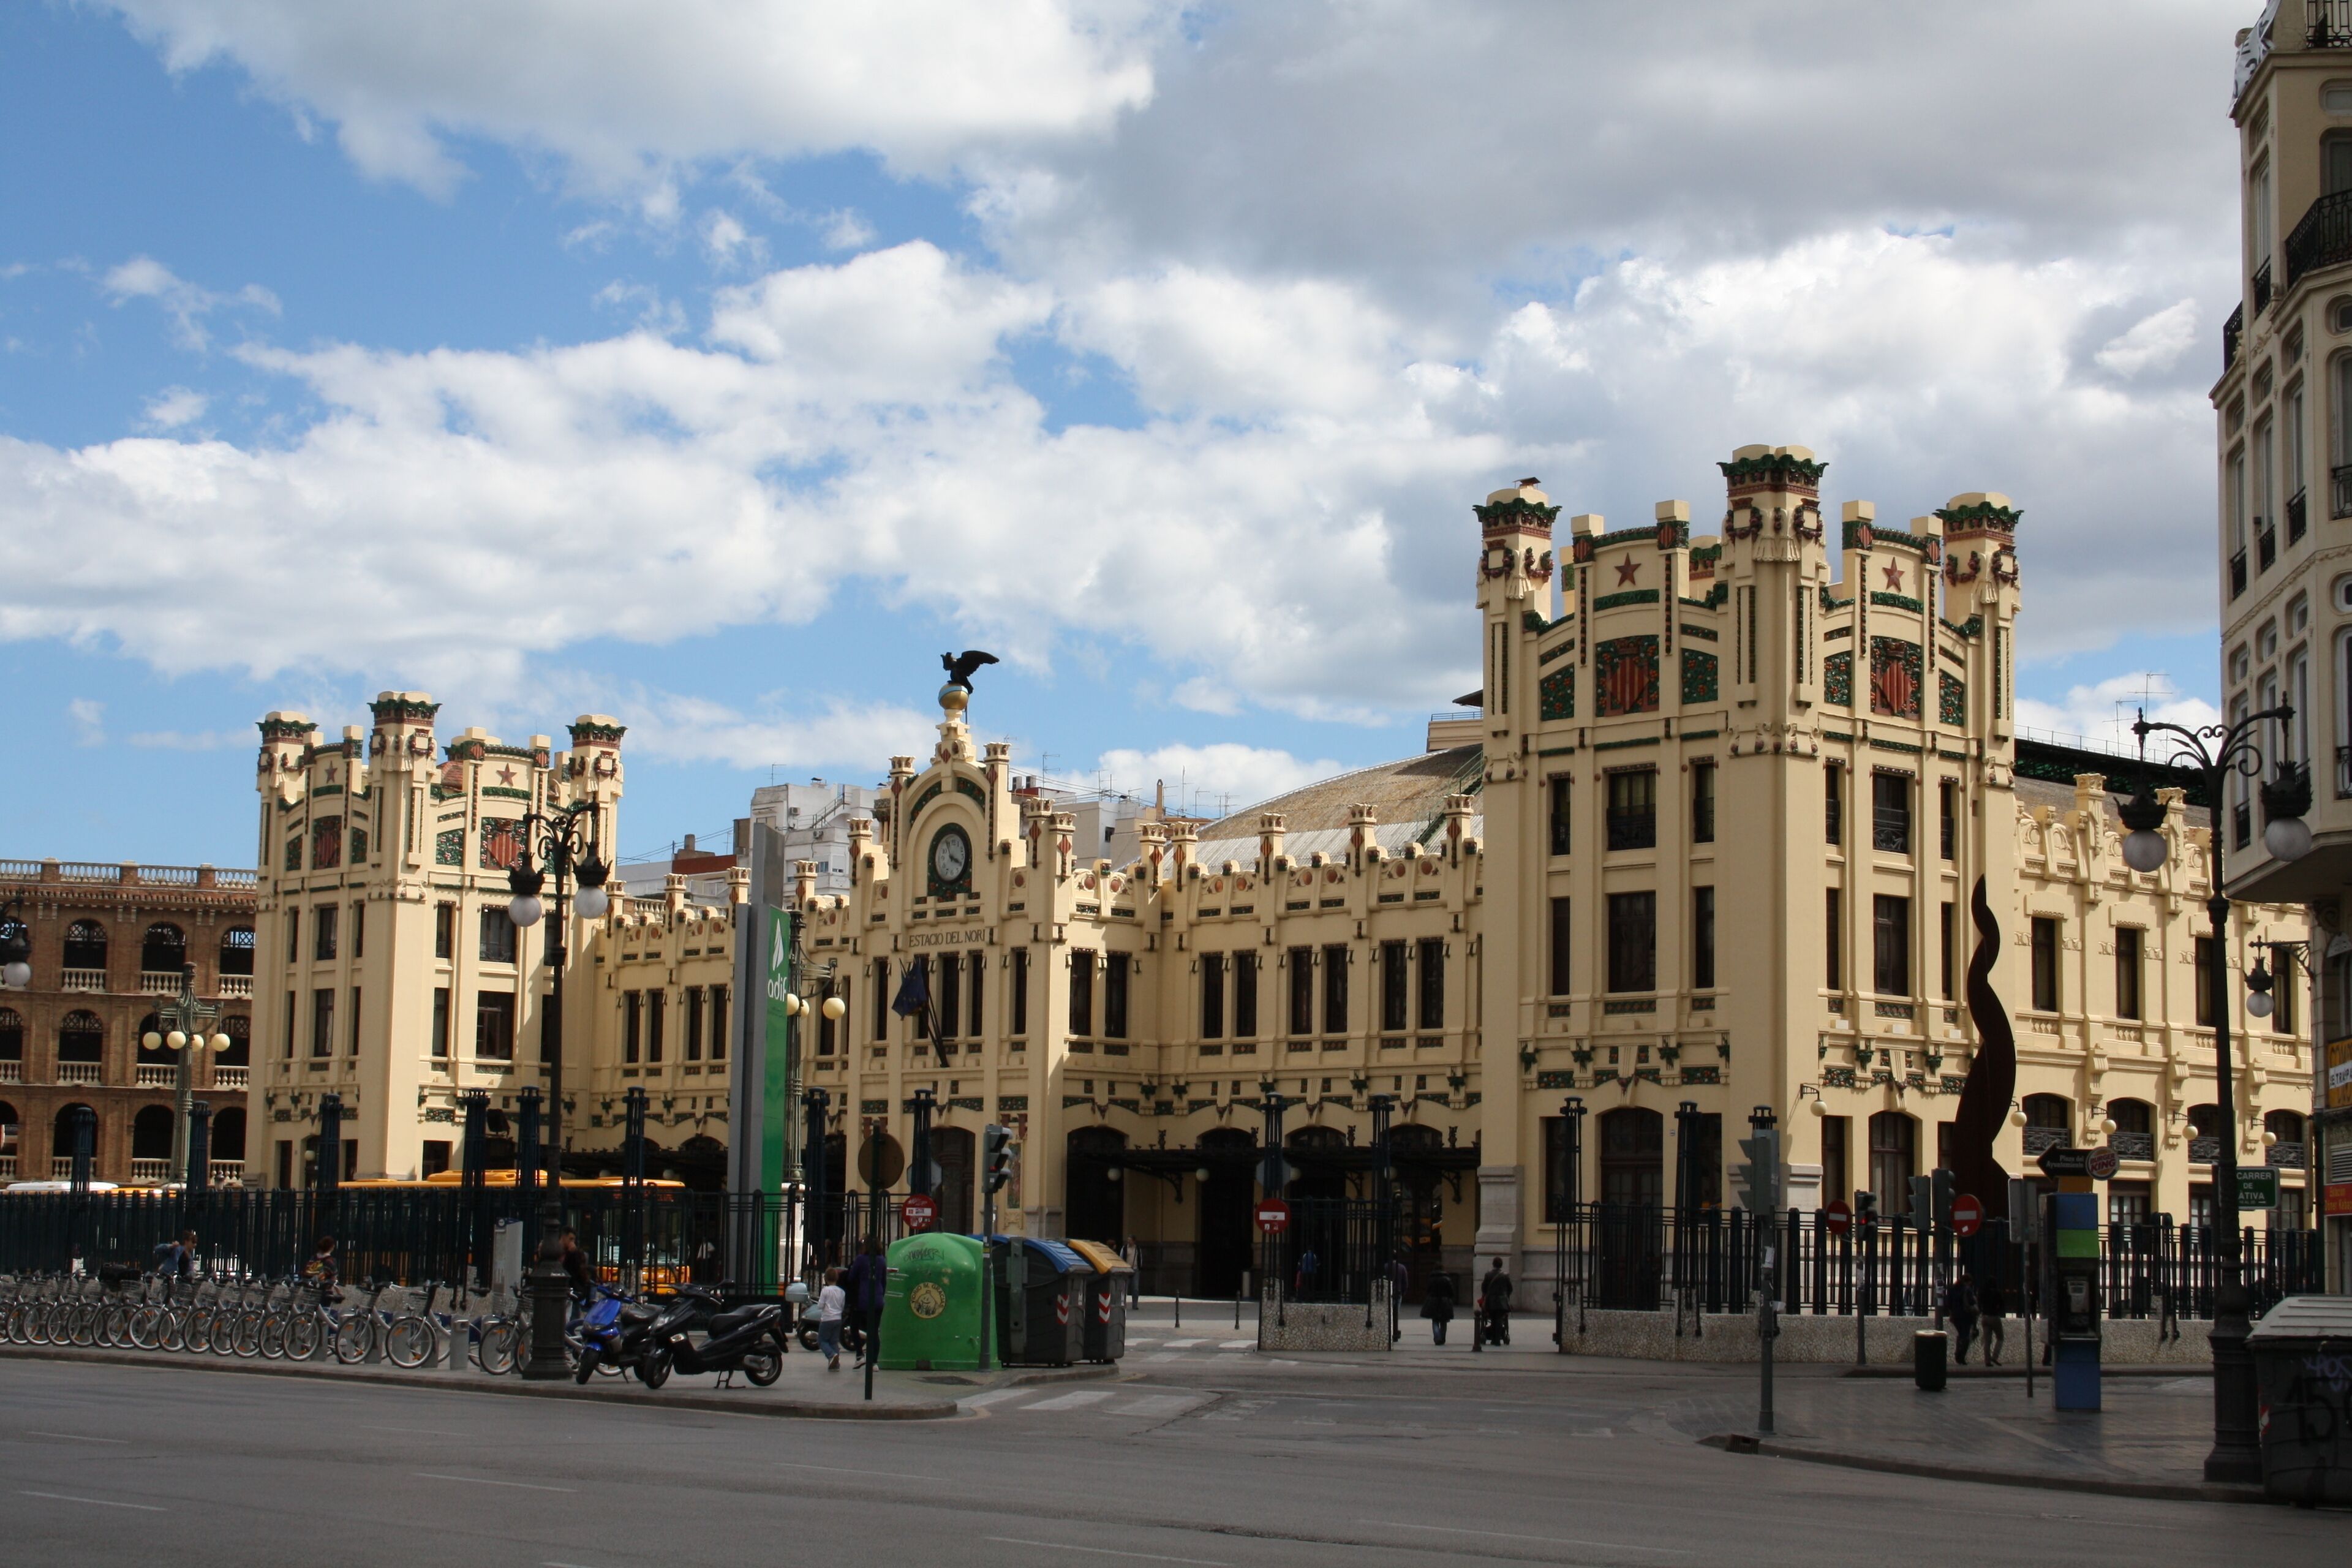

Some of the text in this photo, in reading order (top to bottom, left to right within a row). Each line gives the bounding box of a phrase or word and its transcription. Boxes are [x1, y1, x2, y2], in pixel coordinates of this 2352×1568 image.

[946, 932, 963, 944] DEL
[767, 973, 787, 1002] adif
[2090, 1153, 2115, 1164] BURGER
[2090, 1159, 2117, 1172] KING
[2238, 1189, 2265, 1200] ÀTIVA
